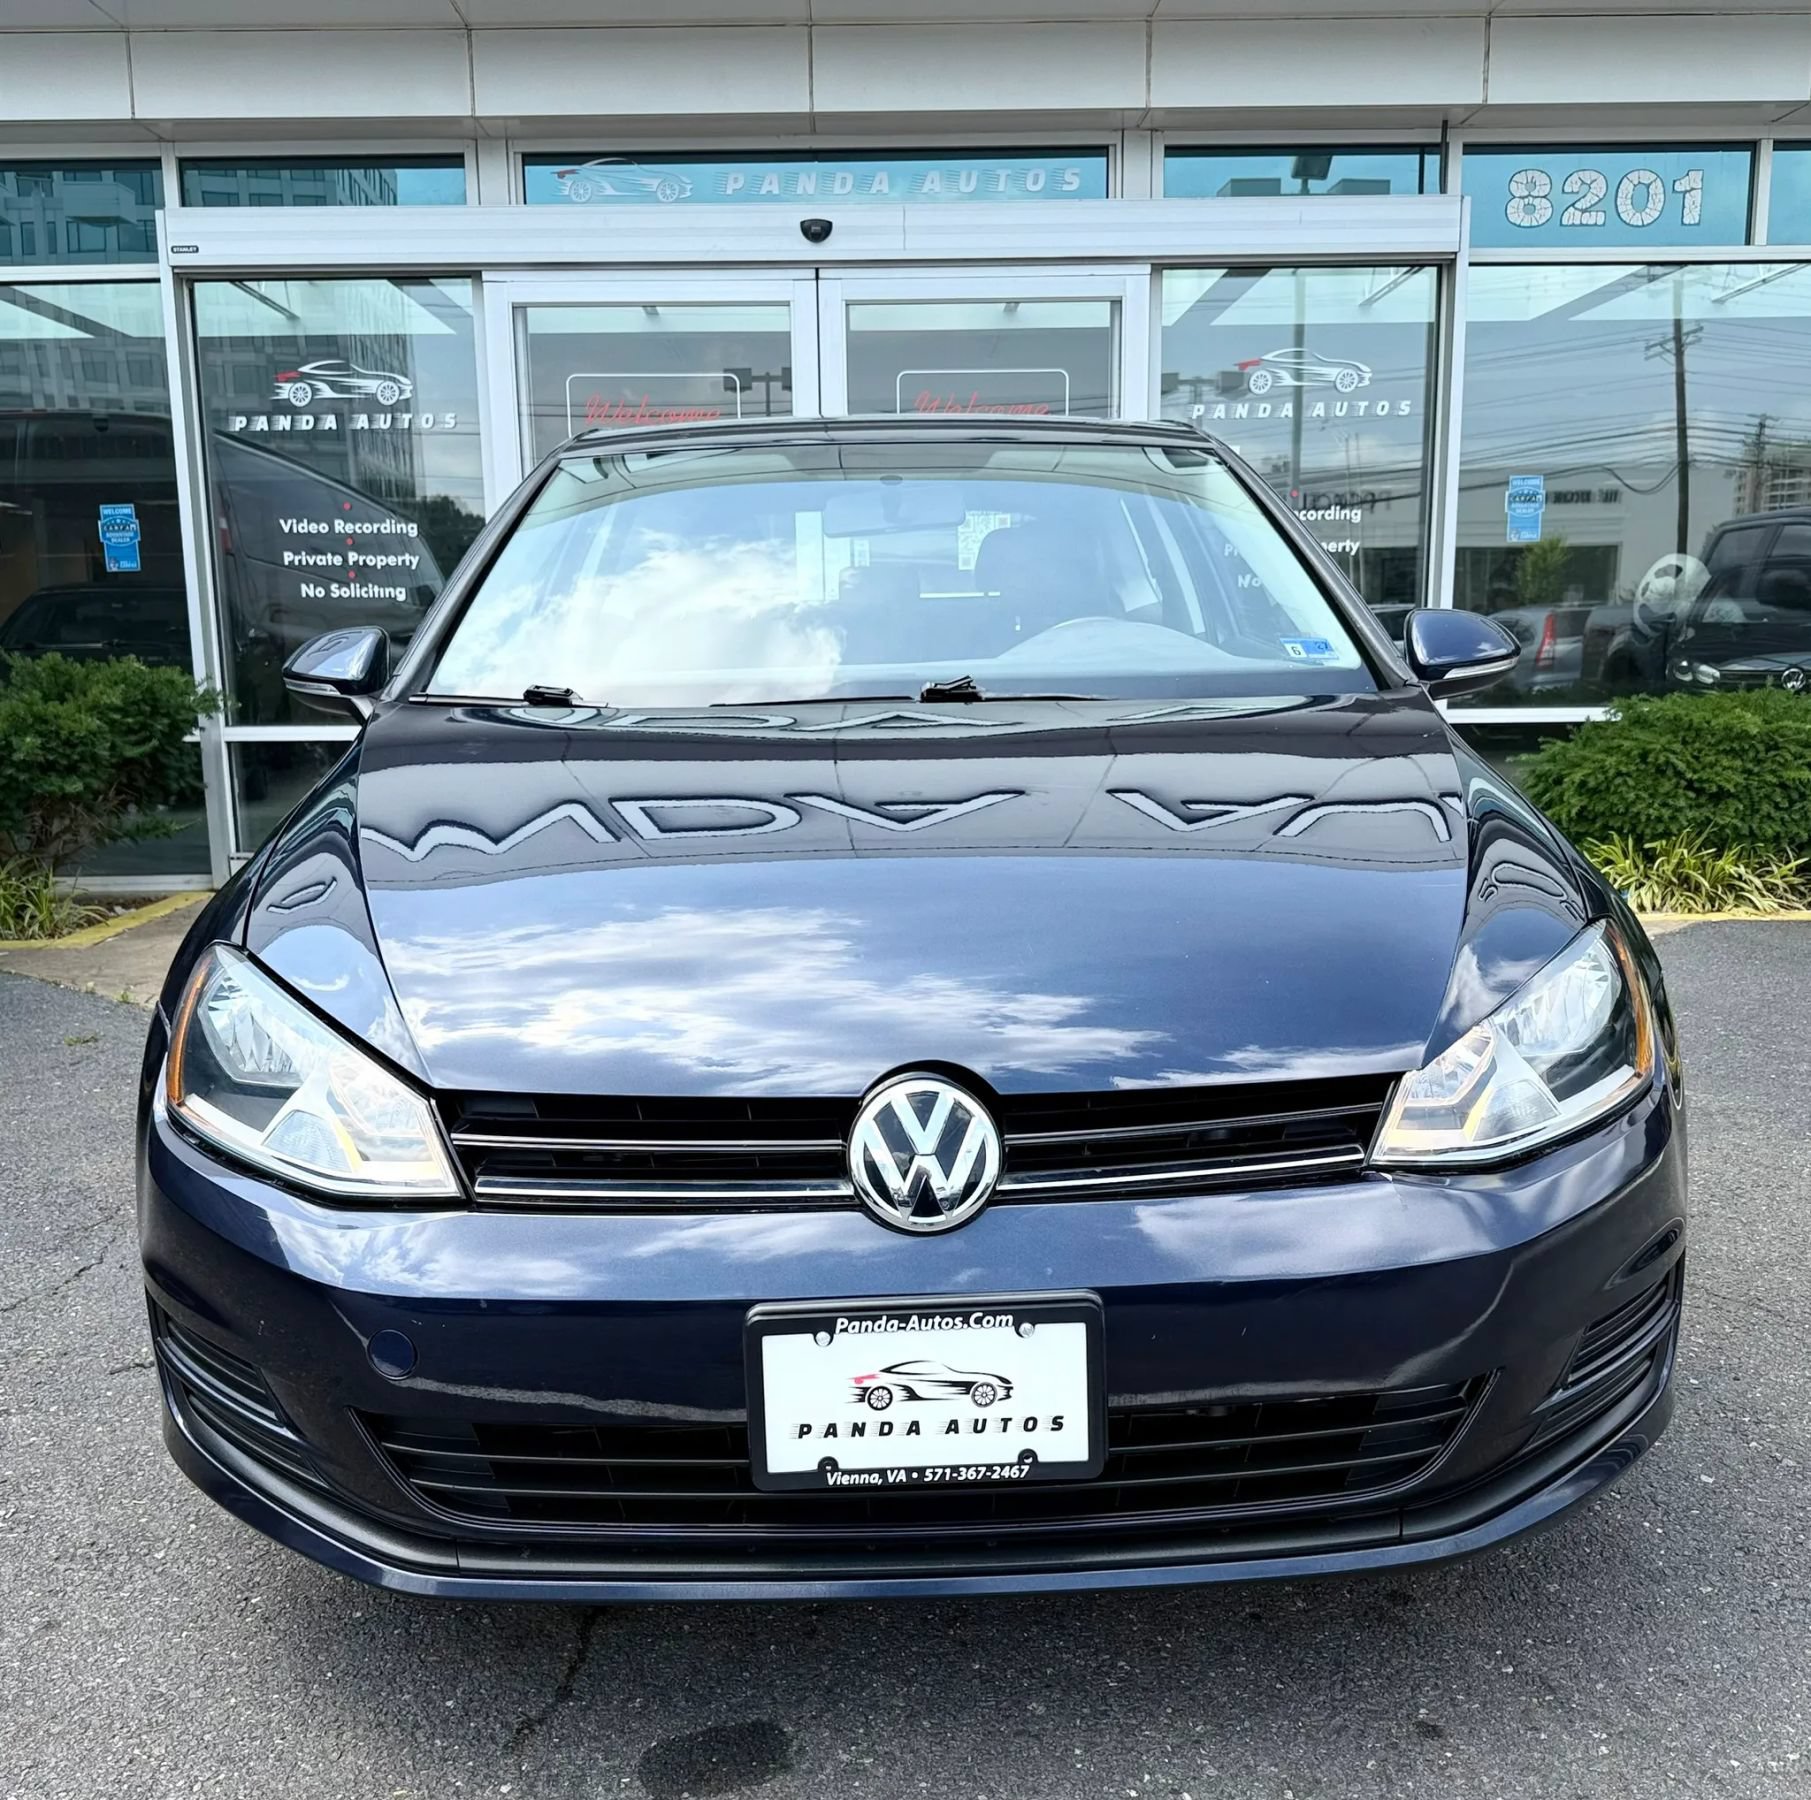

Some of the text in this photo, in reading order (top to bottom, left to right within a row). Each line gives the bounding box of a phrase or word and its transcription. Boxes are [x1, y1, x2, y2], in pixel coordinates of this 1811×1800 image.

[714, 167, 1081, 197] PANDA AUTOS
[1504, 167, 1705, 229] 8201
[1191, 400, 1412, 420] PANDA AUTOS
[230, 412, 457, 432] PANDA AUTOS
[1292, 505, 1362, 523] cording
[279, 519, 418, 537] Video Recording
[283, 551, 420, 569] Private Property
[300, 582, 406, 601] No Soliciting
[835, 1312, 1014, 1334] Panda-Autos.Com
[793, 1414, 1065, 1440] PANDA AUTOS
[826, 1465, 1031, 1486] Vienna, VA 571-367-2467
